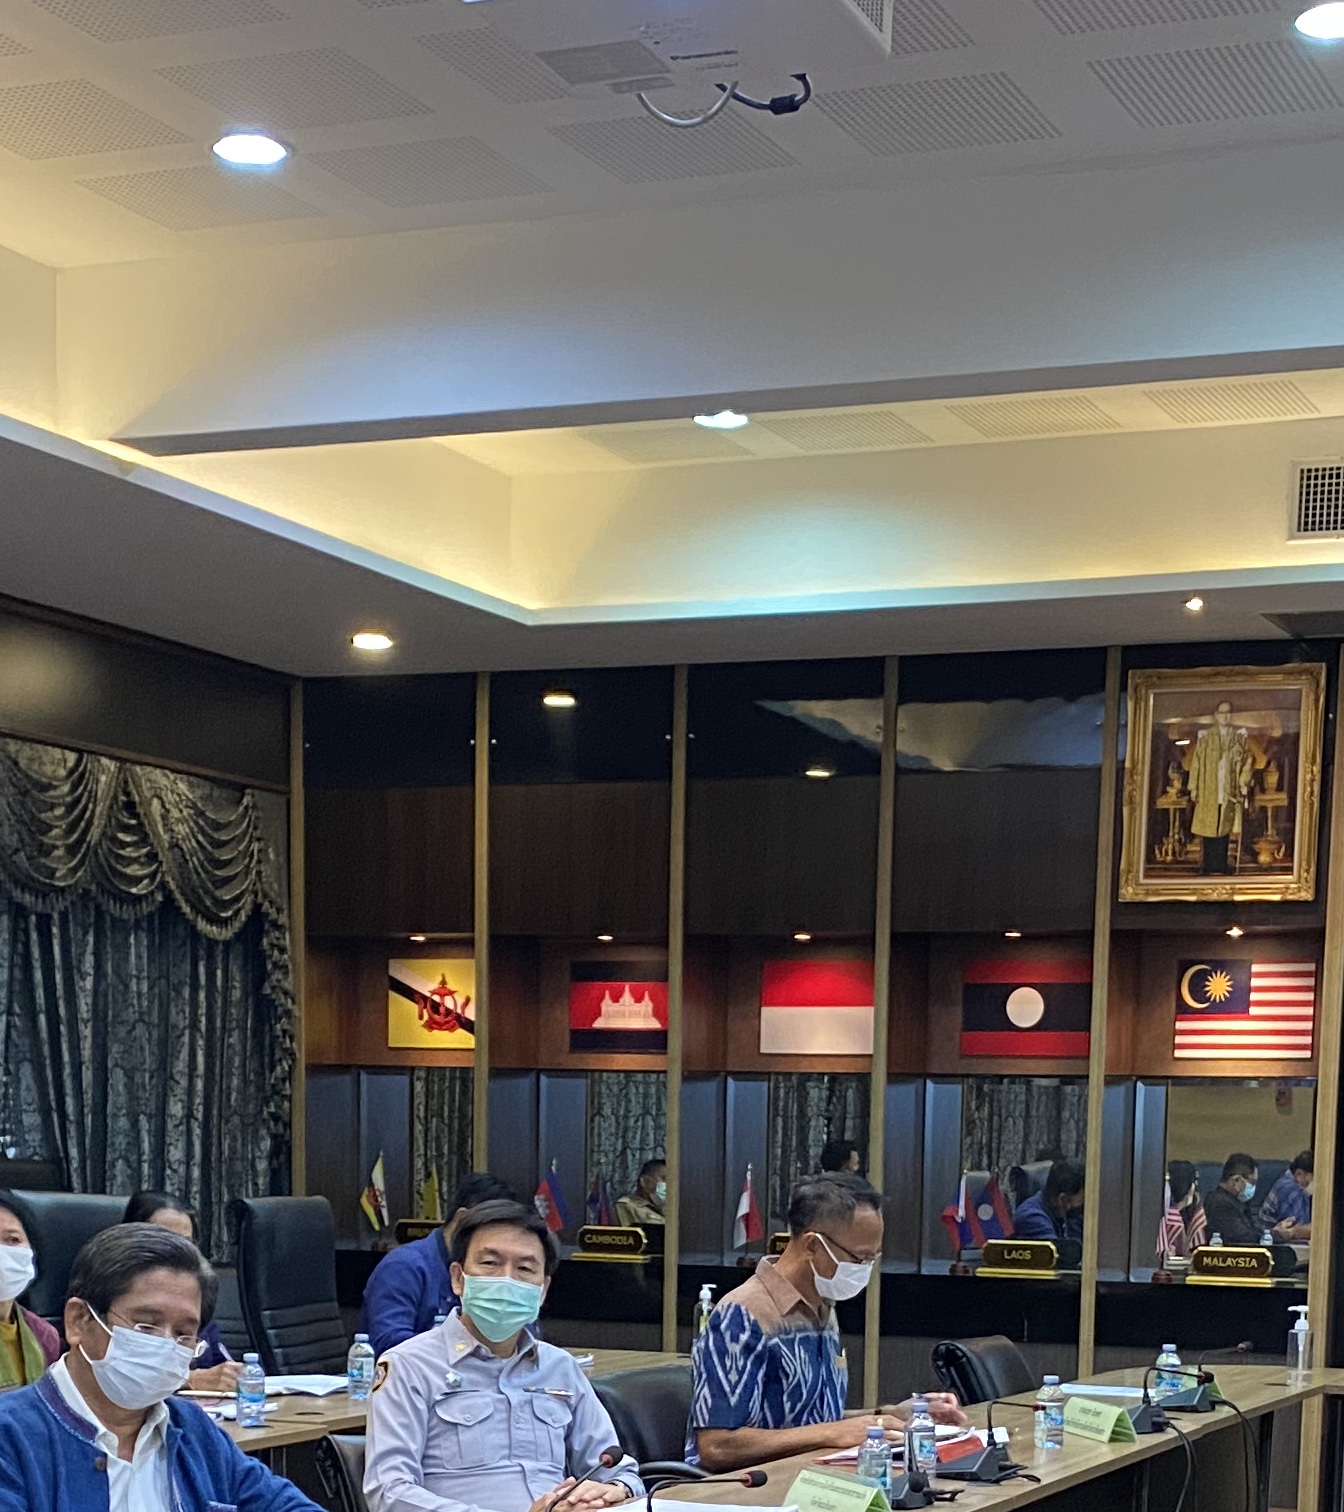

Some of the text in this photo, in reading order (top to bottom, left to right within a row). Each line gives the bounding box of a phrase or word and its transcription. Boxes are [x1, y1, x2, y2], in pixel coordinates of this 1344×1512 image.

[584, 1234, 635, 1245] CAMBODIA
[1003, 1249, 1032, 1260] LAOS
[1202, 1256, 1258, 1268] MALAYSIA
